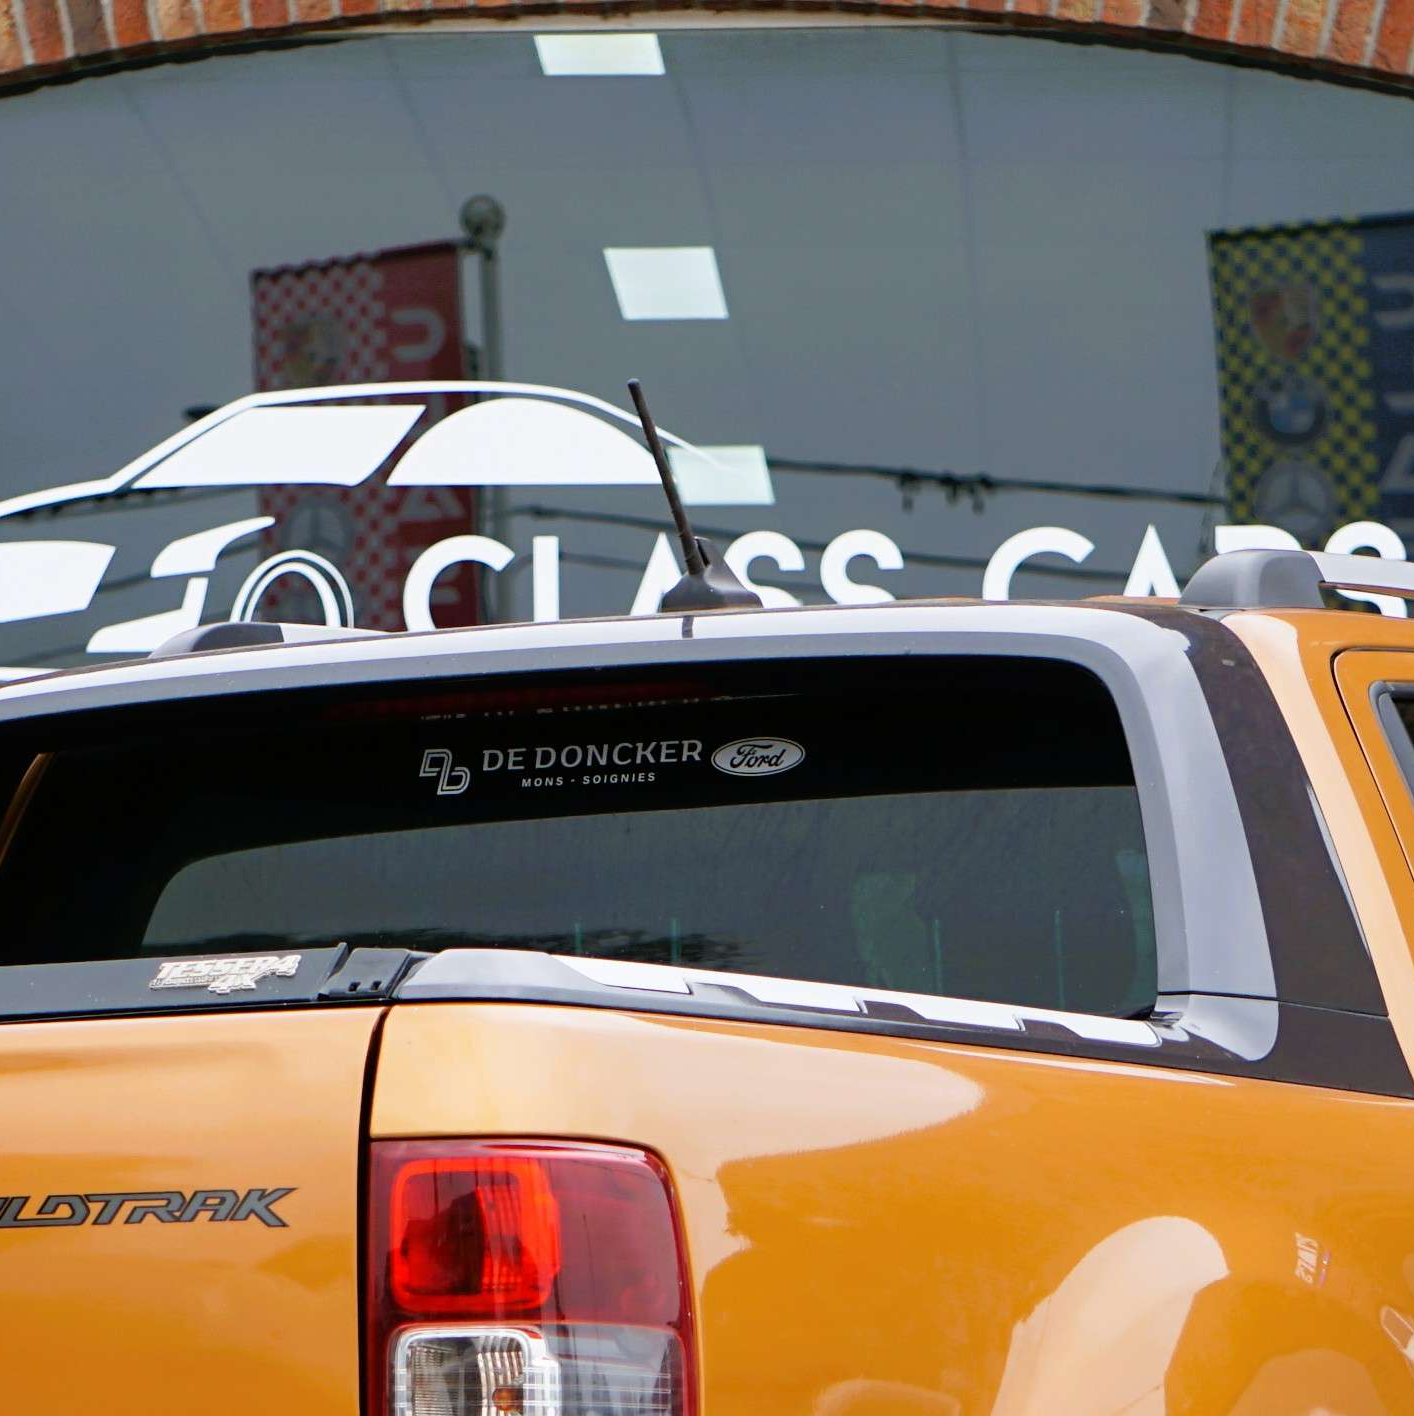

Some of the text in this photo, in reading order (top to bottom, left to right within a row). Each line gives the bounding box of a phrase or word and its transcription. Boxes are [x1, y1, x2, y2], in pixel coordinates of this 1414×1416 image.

[982, 520, 1408, 620] CAS
[481, 747, 527, 772] DE
[533, 738, 704, 770] DONCKER
[520, 776, 565, 788] MONS
[582, 771, 657, 786] SOIGNIES
